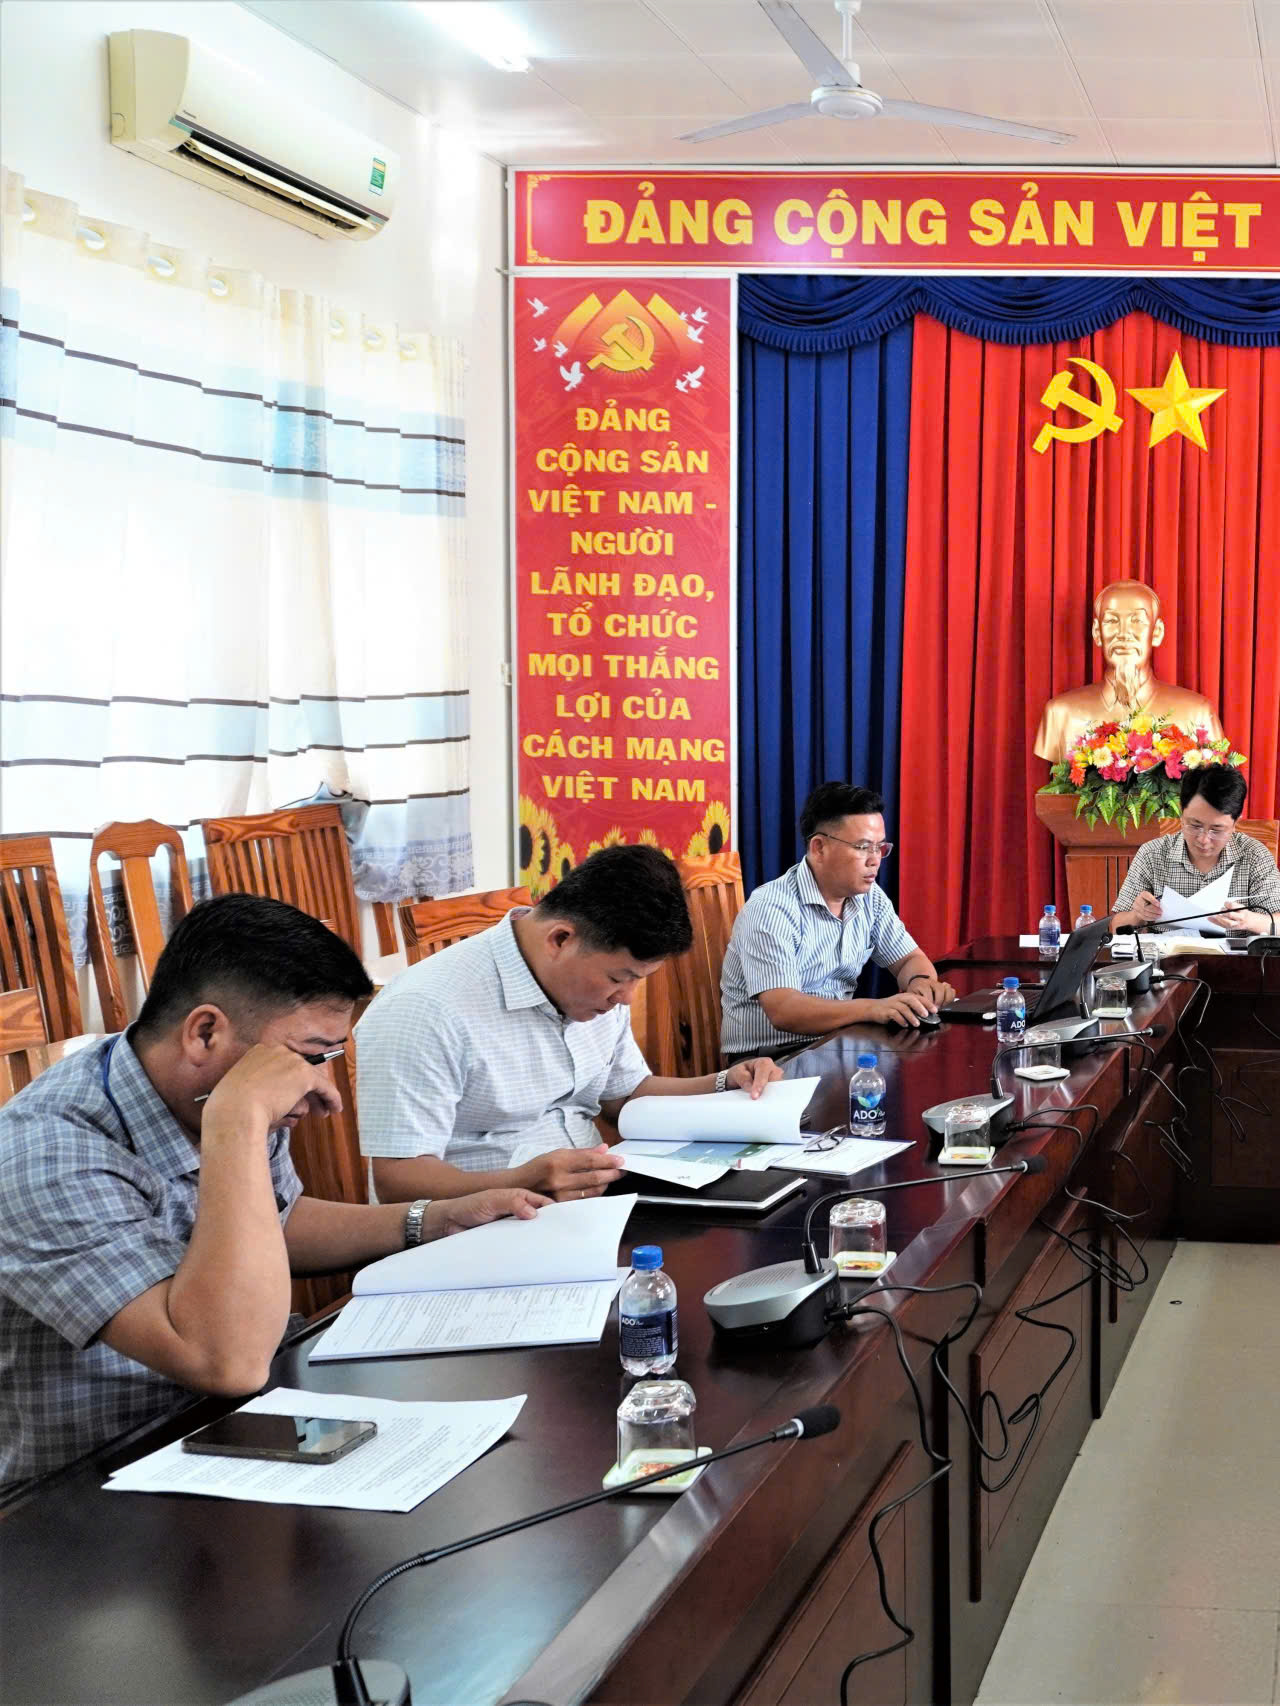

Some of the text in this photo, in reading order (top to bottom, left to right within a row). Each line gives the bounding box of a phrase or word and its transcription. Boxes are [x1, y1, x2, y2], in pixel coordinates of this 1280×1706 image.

[583, 181, 753, 245] ĐẢNG
[774, 188, 947, 258] CỘNG
[968, 181, 1094, 247] SẢN
[1116, 191, 1262, 262] VIỆT
[575, 399, 671, 432] ĐẢNG
[535, 440, 709, 477] CỘNG SẢN
[527, 483, 606, 518] VIỆT
[618, 490, 694, 515] NAM
[570, 526, 674, 556] NGƯỜI
[529, 565, 715, 603] LÃNH ĐẠO,
[546, 601, 699, 639] TỔ CHỨC
[527, 645, 720, 682] MỌI THẮNG
[555, 687, 692, 723] LỢI CỦA
[522, 728, 726, 766] CÁCH MẠNG
[541, 769, 706, 804] VIỆT NAM
[853, 1109, 878, 1120] ADO
